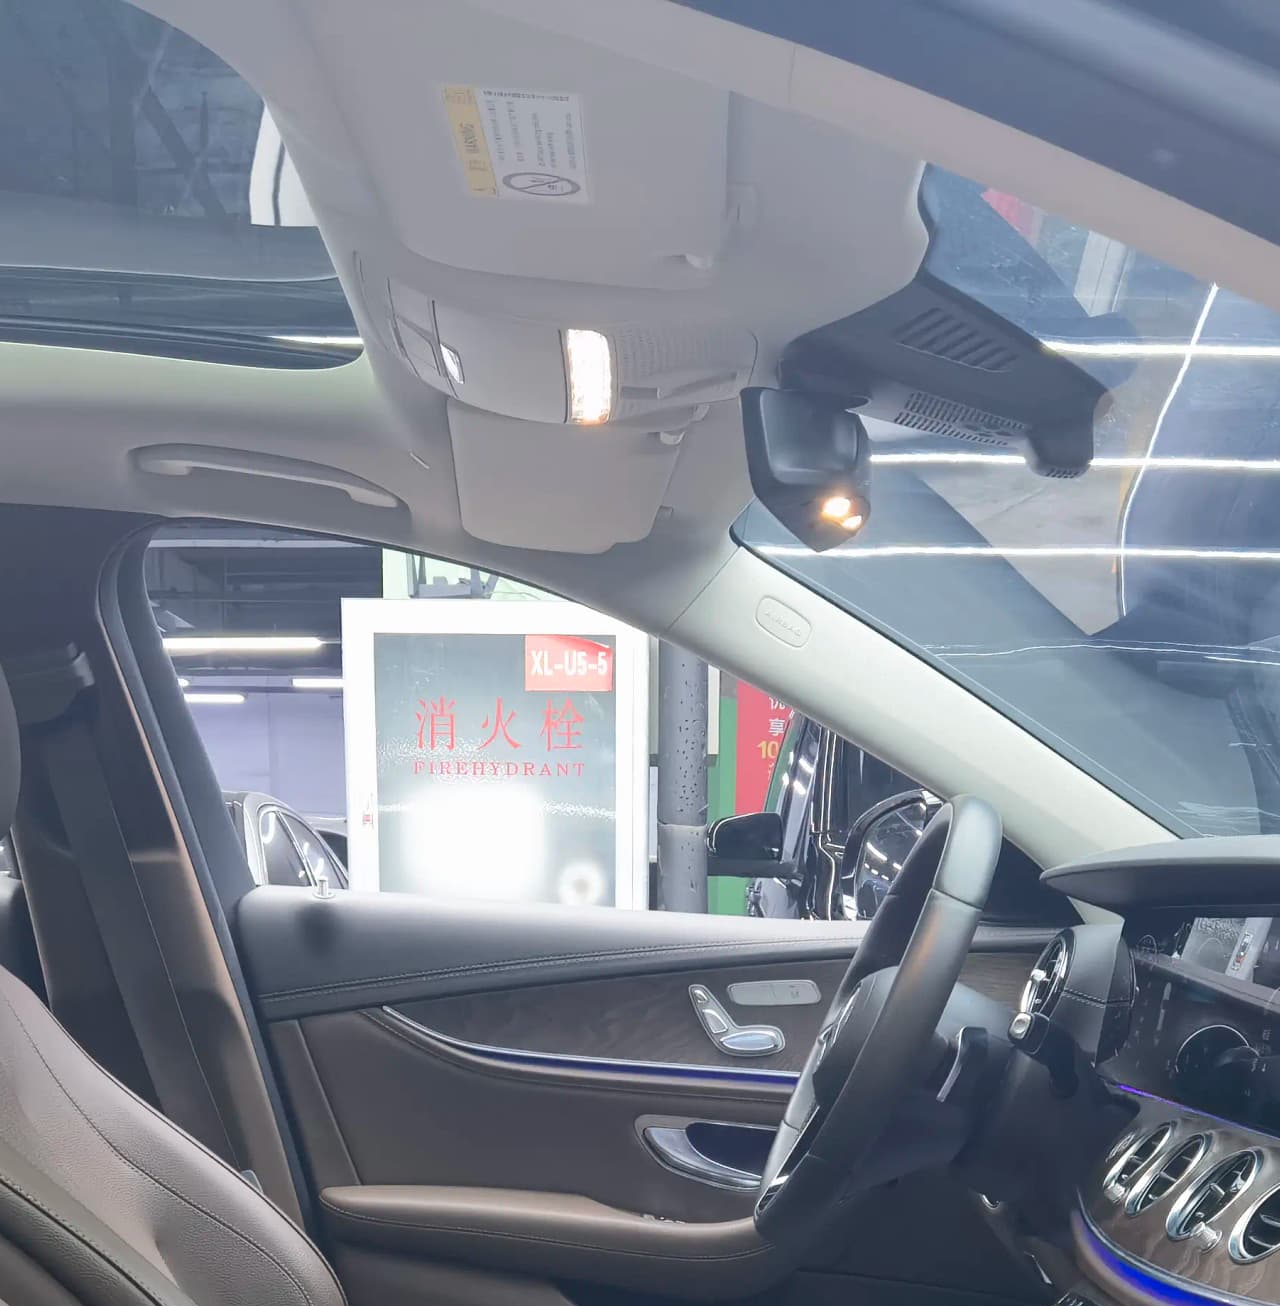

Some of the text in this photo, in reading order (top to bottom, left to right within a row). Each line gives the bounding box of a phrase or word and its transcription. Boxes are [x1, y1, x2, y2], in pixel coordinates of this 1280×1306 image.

[530, 649, 608, 676] XL-U5-5
[415, 695, 585, 752] 消火栓
[413, 761, 586, 777] FIREHYDRANT
